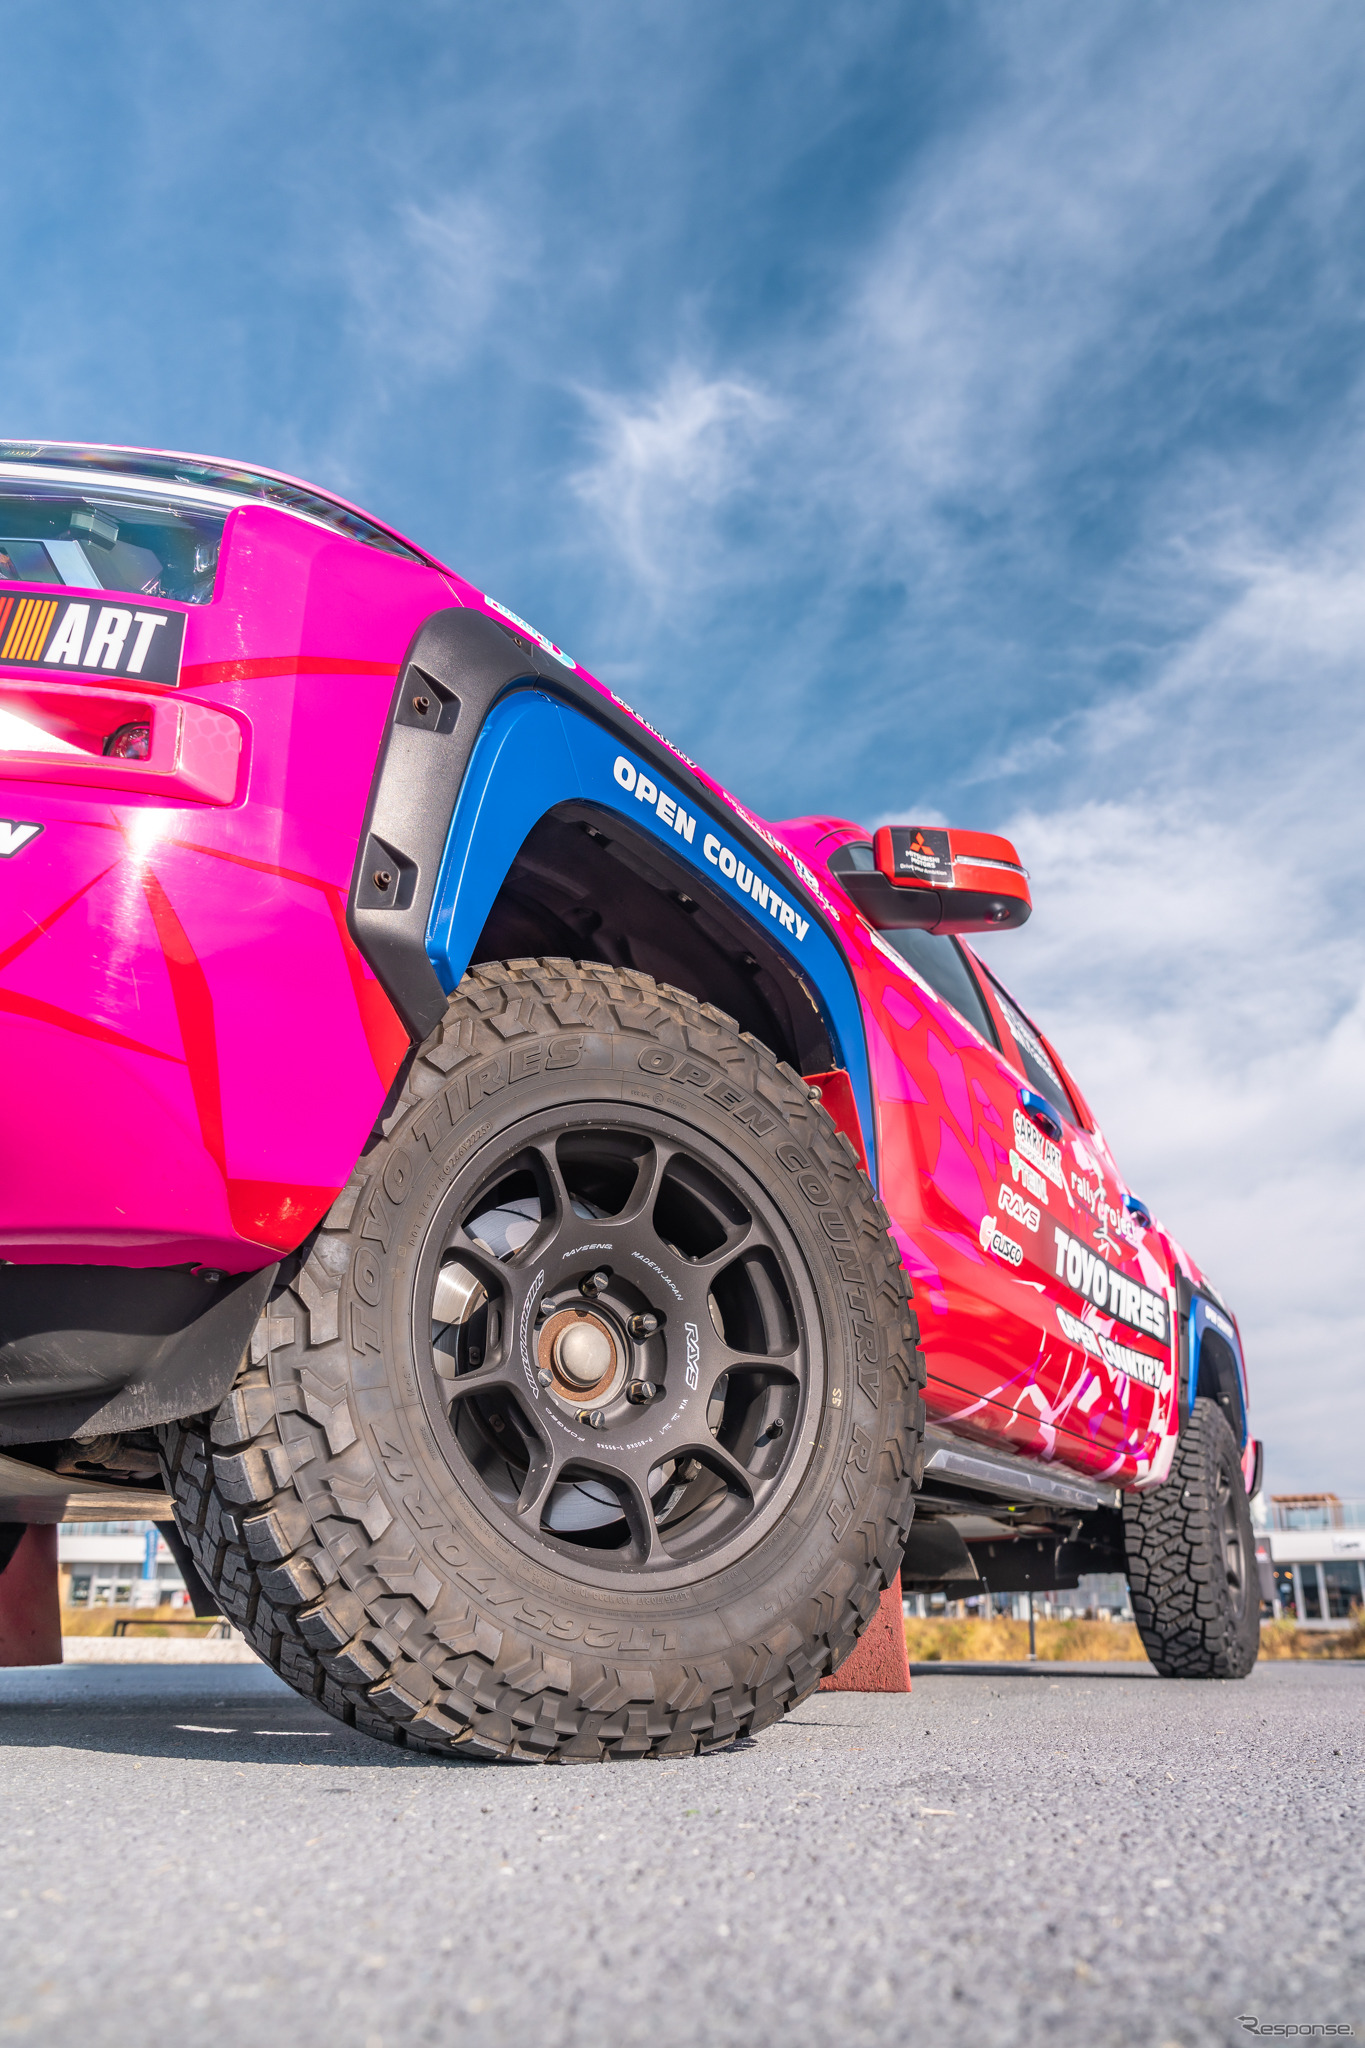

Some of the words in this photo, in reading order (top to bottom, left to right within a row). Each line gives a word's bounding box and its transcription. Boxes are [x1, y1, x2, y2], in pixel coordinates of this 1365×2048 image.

[44, 602, 168, 674] ART
[613, 756, 697, 844] OPEN
[703, 832, 810, 943] COUNTRY
[905, 850, 940, 863] MITSUBISHI
[911, 857, 937, 869] MOTORS
[637, 1045, 778, 1138] OPEN
[1014, 1112, 1044, 1155] CARRY
[1045, 1143, 1061, 1172] ART
[352, 1146, 414, 1357] TOYO
[411, 1034, 585, 1153] TIRES
[998, 1183, 1041, 1233] RAYS
[1071, 1171, 1097, 1213] rally
[774, 1142, 879, 1410] COUNTRY
[991, 1231, 1023, 1265] CUSCO
[660, 1273, 684, 1301] JAPAN
[1054, 1226, 1108, 1307] TOYO
[1109, 1269, 1166, 1340] TIRES
[685, 1322, 699, 1390] RAYS
[1056, 1304, 1102, 1358] OPEN
[1098, 1334, 1164, 1389] COUNTRY
[544, 1406, 586, 1442] FORGED
[678, 1398, 689, 1410] VIA
[825, 1422, 874, 1544] R/T
